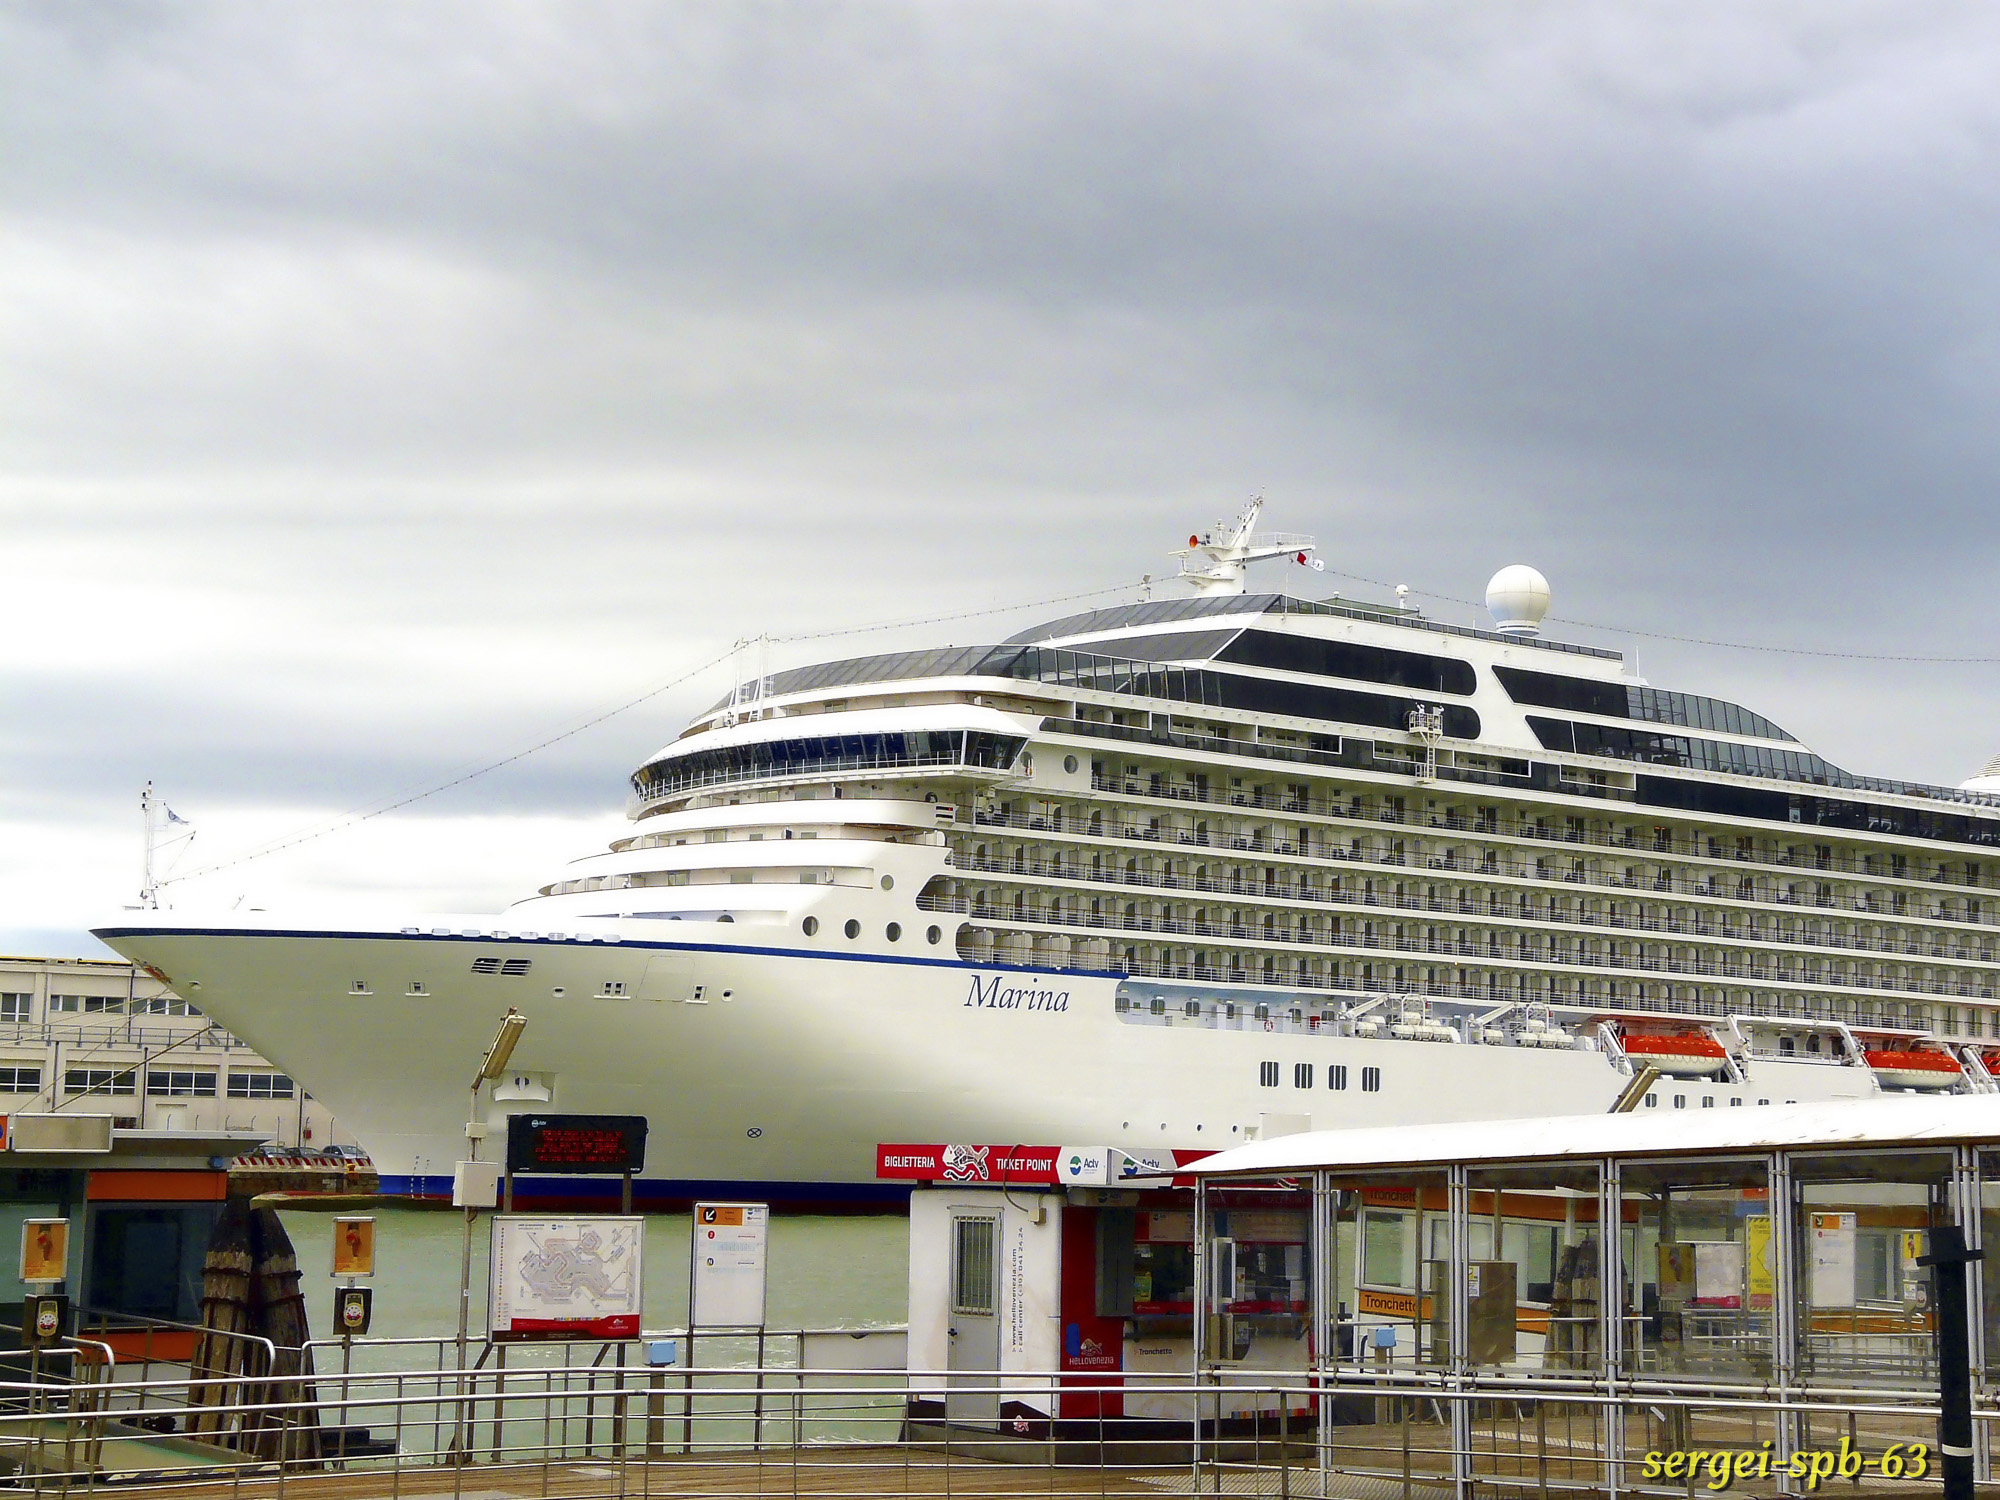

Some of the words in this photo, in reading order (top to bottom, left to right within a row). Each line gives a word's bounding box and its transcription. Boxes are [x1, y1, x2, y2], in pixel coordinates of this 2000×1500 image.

[963, 974, 1070, 1012] Marina
[884, 1155, 936, 1168] BIGLIETTERIA
[996, 1158, 1025, 1170] TICKET
[1026, 1158, 1053, 1171] POINT
[1083, 1158, 1099, 1169] Actv
[1138, 1348, 1173, 1356] Tronchetto
